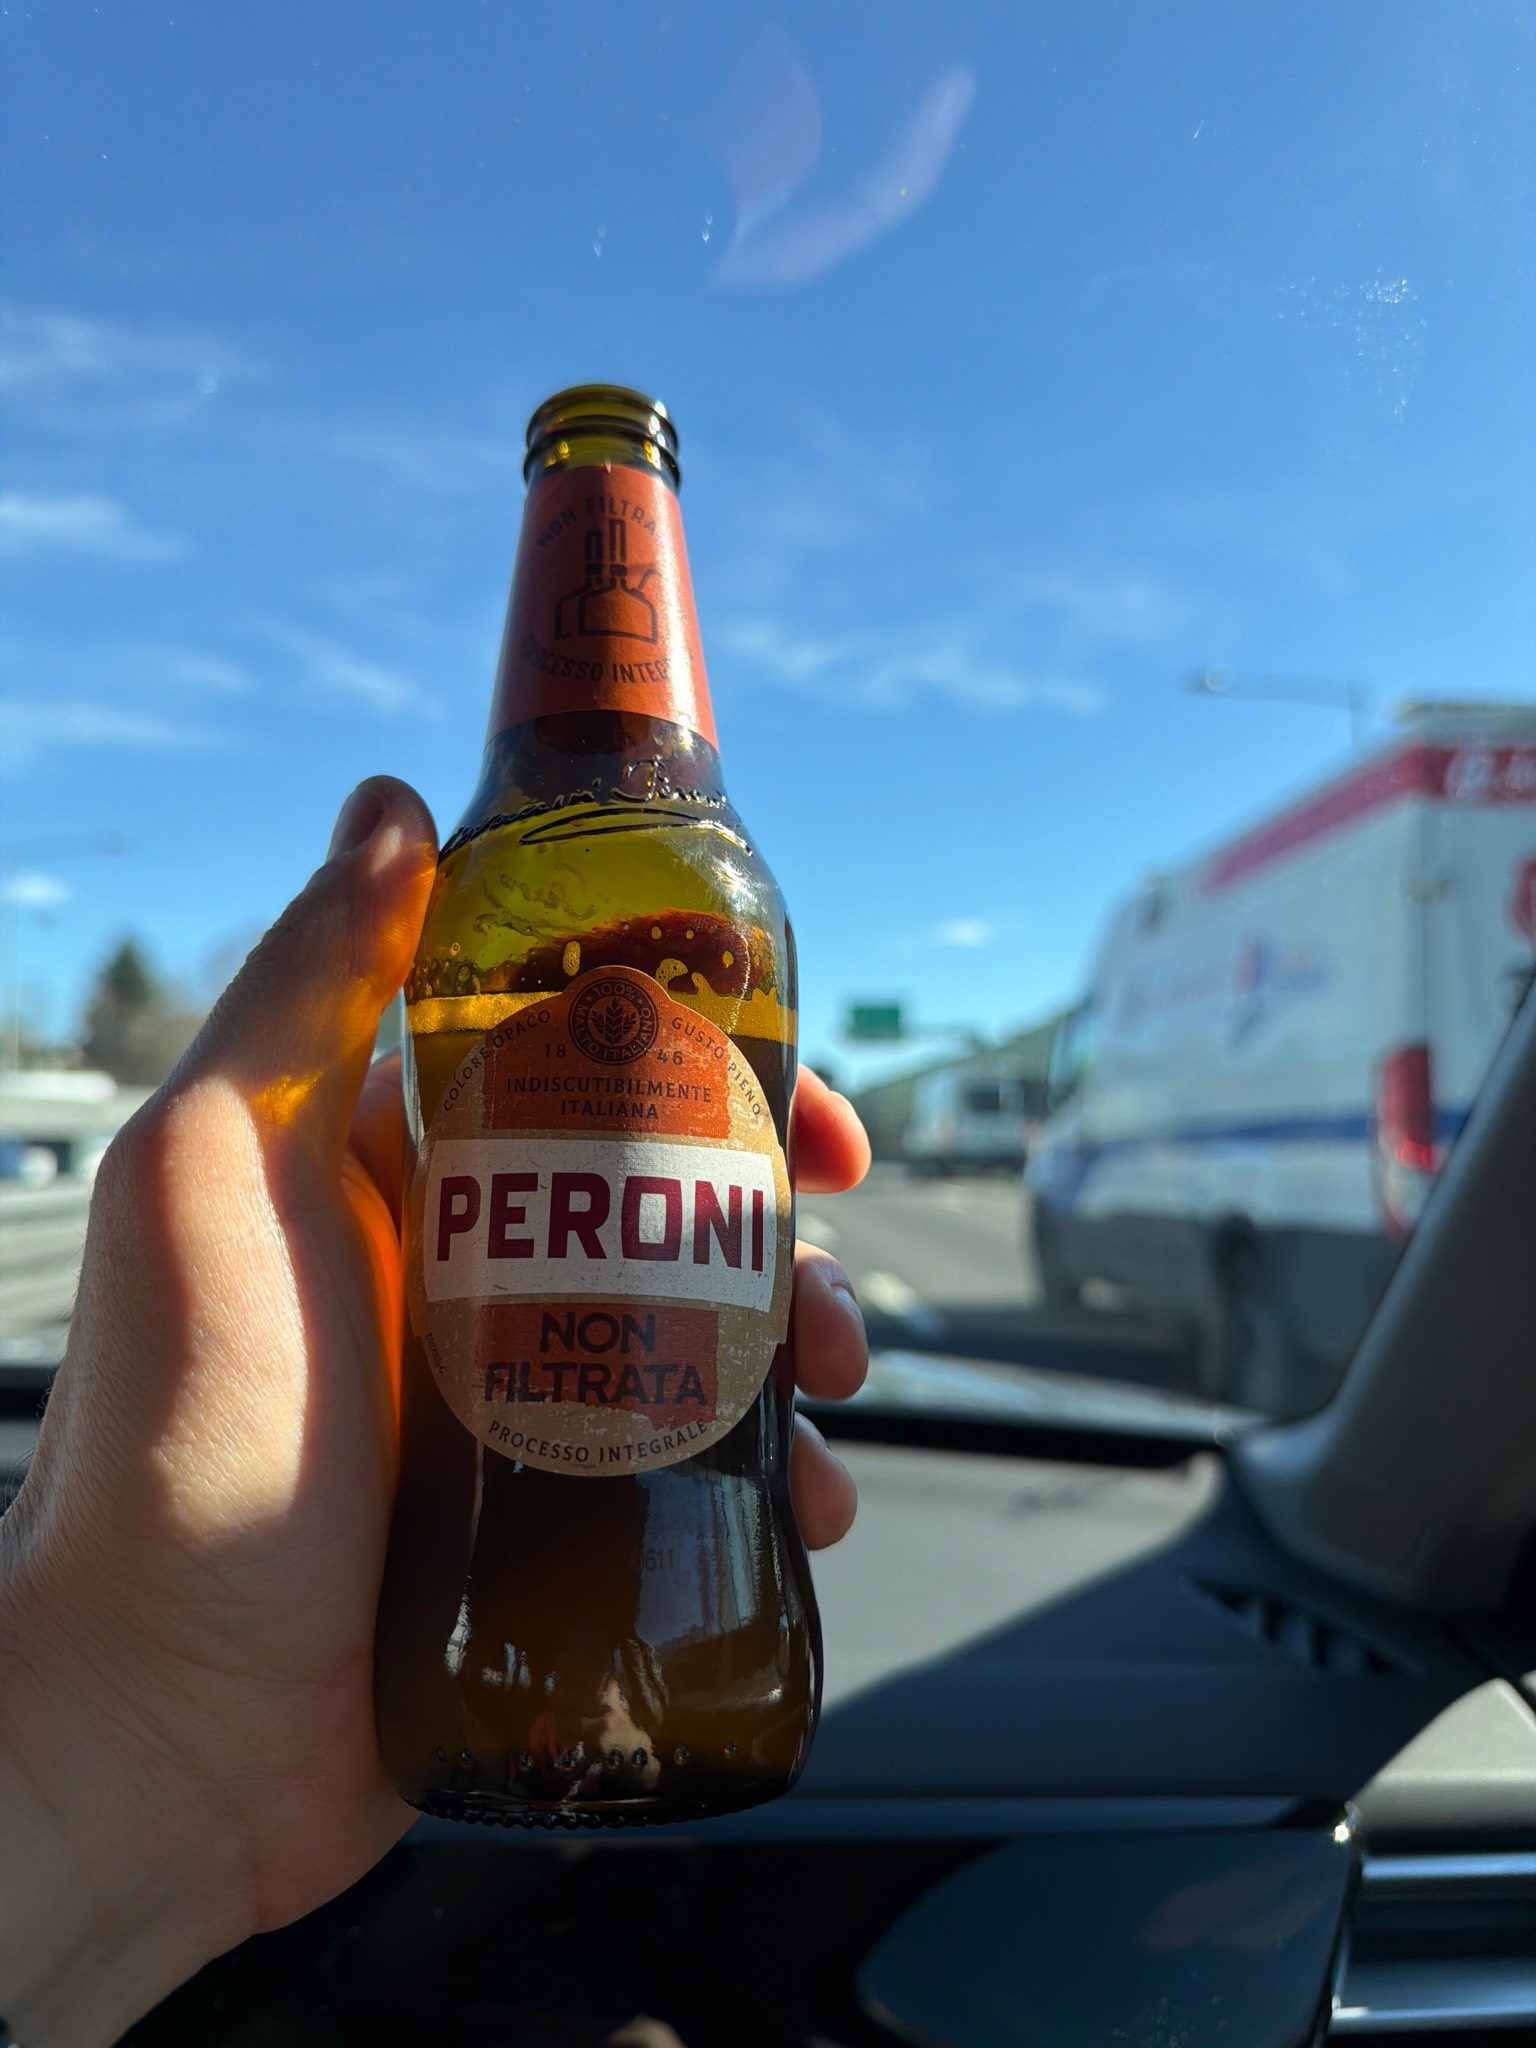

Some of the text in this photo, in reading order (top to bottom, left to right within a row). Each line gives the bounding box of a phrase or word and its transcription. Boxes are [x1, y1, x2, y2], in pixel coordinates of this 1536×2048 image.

[537, 506, 577, 547] NON
[593, 983, 636, 1001] 100%
[573, 1003, 654, 1060] MALTO ITALIANO
[443, 1009, 551, 1112] COLORE OPACO
[543, 1042, 684, 1066] 18 46
[671, 1016, 762, 1116] GUSTO PIENO
[505, 1076, 713, 1104] INDISCUTIBILMENTE
[560, 1099, 659, 1120] ITALIANA
[436, 1171, 765, 1273] PERONI
[538, 1310, 656, 1354] NON
[484, 1361, 706, 1406] FILTRATA
[488, 1419, 708, 1463] PROCESSO INTEGRALE
